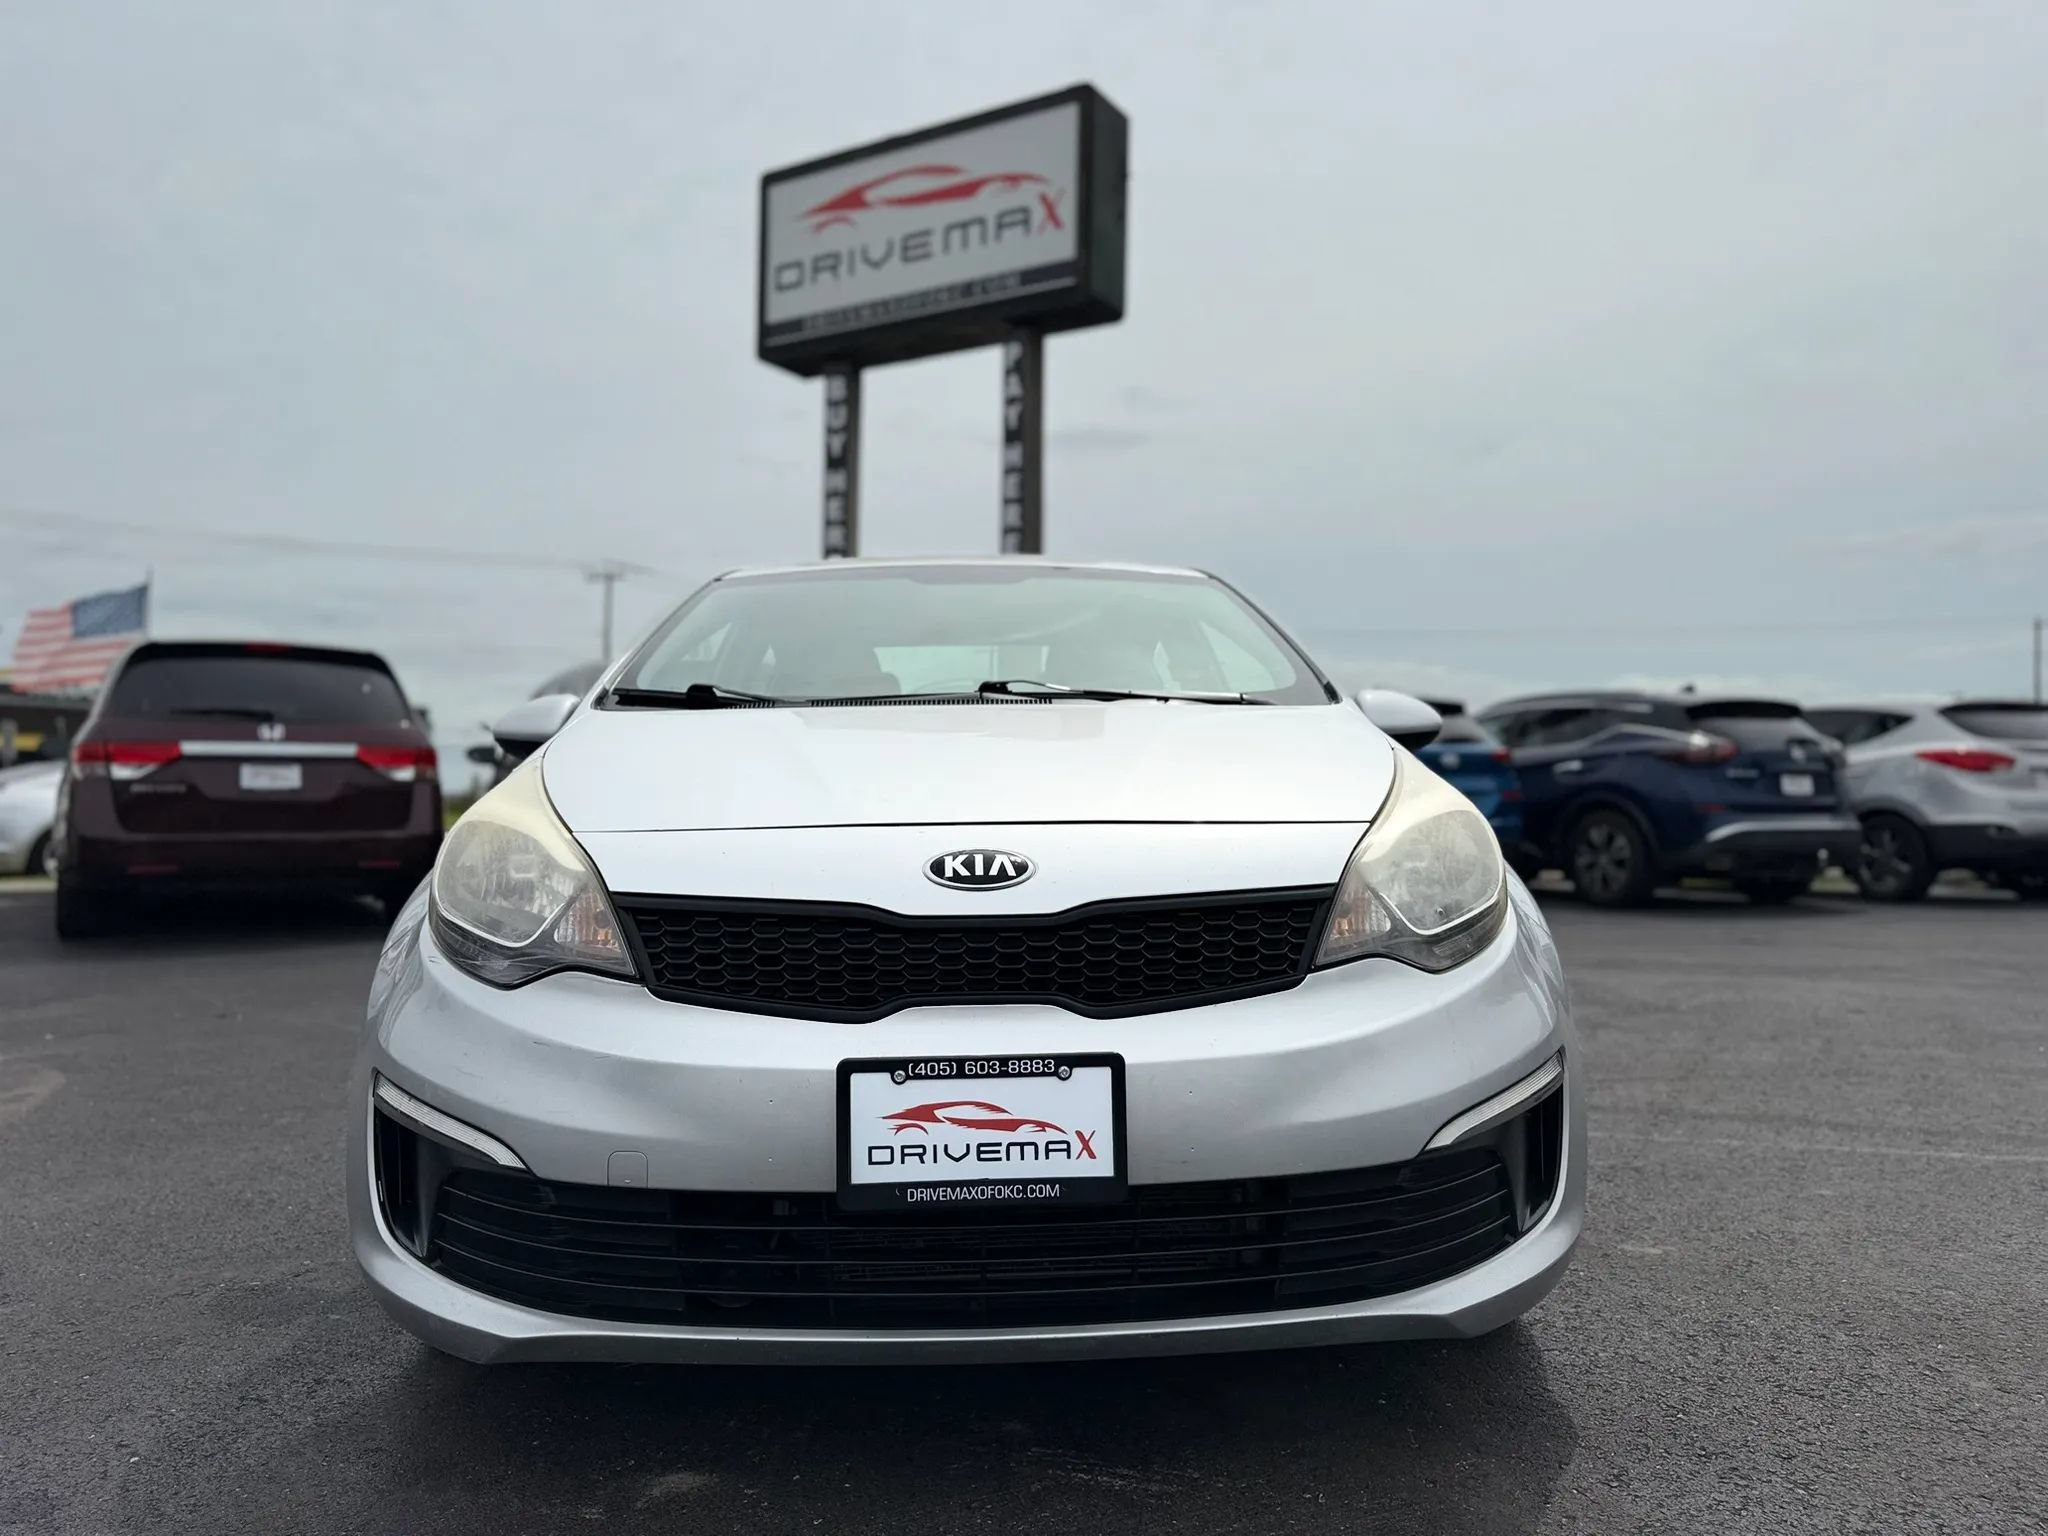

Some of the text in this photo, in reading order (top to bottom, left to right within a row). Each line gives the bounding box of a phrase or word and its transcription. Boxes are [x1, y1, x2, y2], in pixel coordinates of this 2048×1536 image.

[774, 188, 1065, 292] DRIVEMAX
[943, 853, 1017, 878] KIA
[908, 1059, 1056, 1077] (405) 603-8883
[867, 1130, 1097, 1166] DRIVEMAX
[907, 1184, 1060, 1202] DRIVEMAXOFOKC.COM
